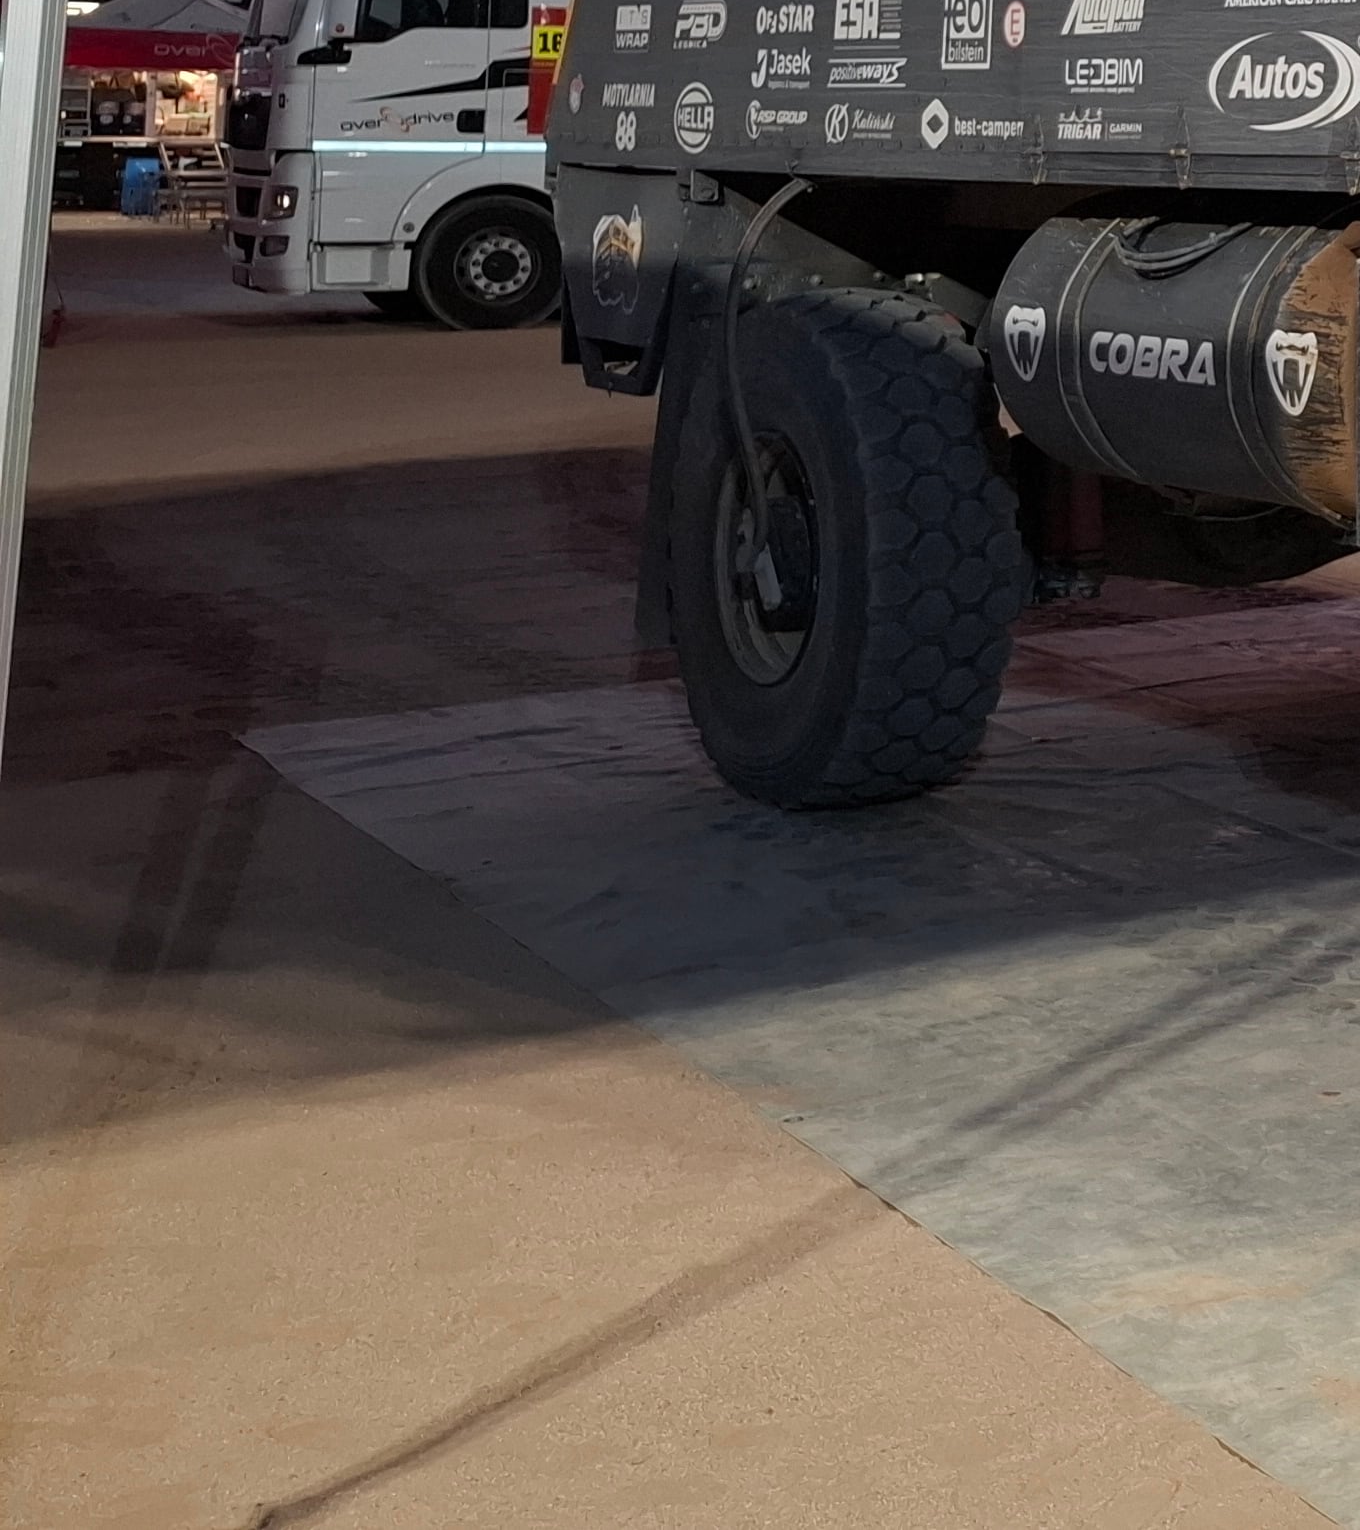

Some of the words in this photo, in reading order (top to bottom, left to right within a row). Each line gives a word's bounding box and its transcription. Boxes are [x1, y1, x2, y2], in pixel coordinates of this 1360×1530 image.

[1010, 8, 1021, 36] E
[1113, 21, 1142, 33] BATTERY
[616, 32, 648, 48] WRAP
[948, 40, 984, 62] bilstein
[769, 47, 812, 76] Jasek
[1065, 58, 1144, 86] LEDBIM
[1229, 55, 1325, 99] Autos
[602, 83, 655, 107] MOTYLARNIA
[677, 105, 714, 130] HELLA
[776, 111, 808, 125] GROUP
[615, 111, 637, 152] 88
[1058, 122, 1102, 140] TRIGAR
[1109, 123, 1142, 134] GARMIN
[1088, 331, 1216, 386] COBRA
